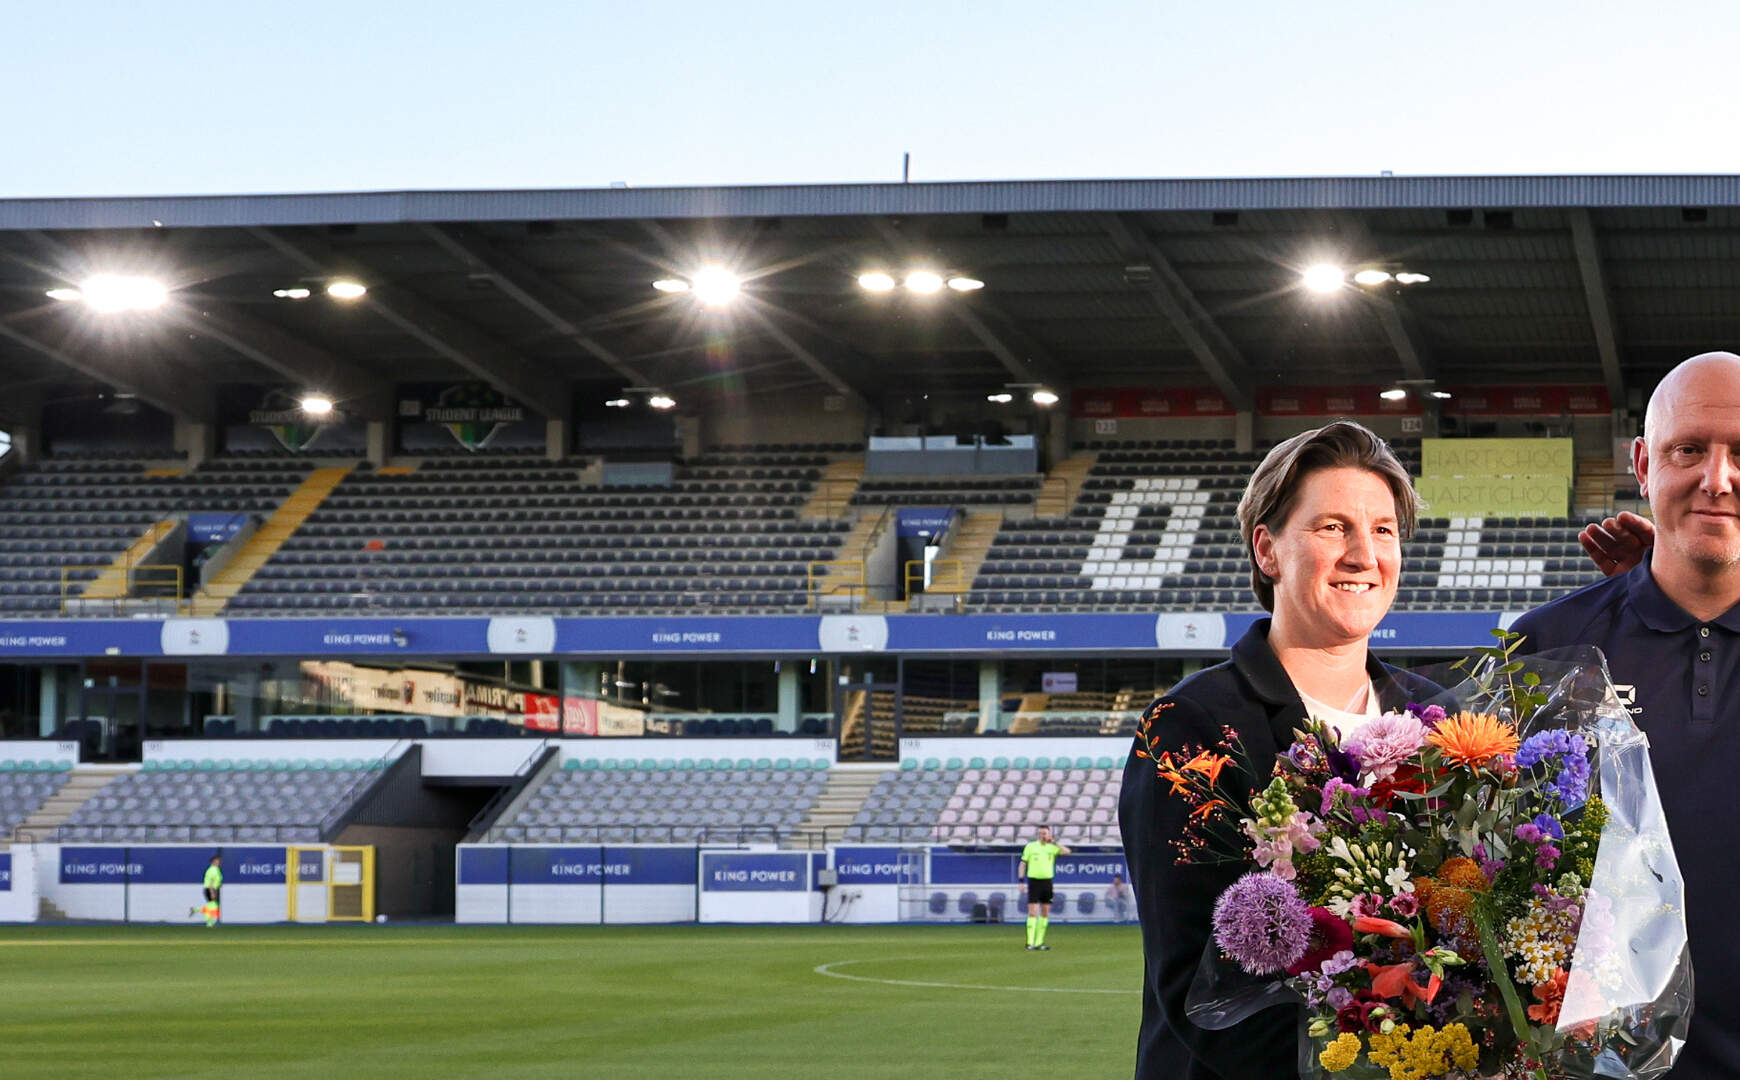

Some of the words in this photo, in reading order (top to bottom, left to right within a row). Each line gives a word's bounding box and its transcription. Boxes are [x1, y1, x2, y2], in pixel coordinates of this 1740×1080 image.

[987, 631, 1015, 641] KING
[1017, 631, 1055, 641] POWER
[1368, 629, 1396, 639] WER
[274, 863, 318, 875] PER
[839, 864, 871, 875] KING
[1056, 863, 1076, 874] NG
[1078, 863, 1123, 874] POWER
[715, 870, 748, 882] KING
[750, 870, 796, 882] POWER
